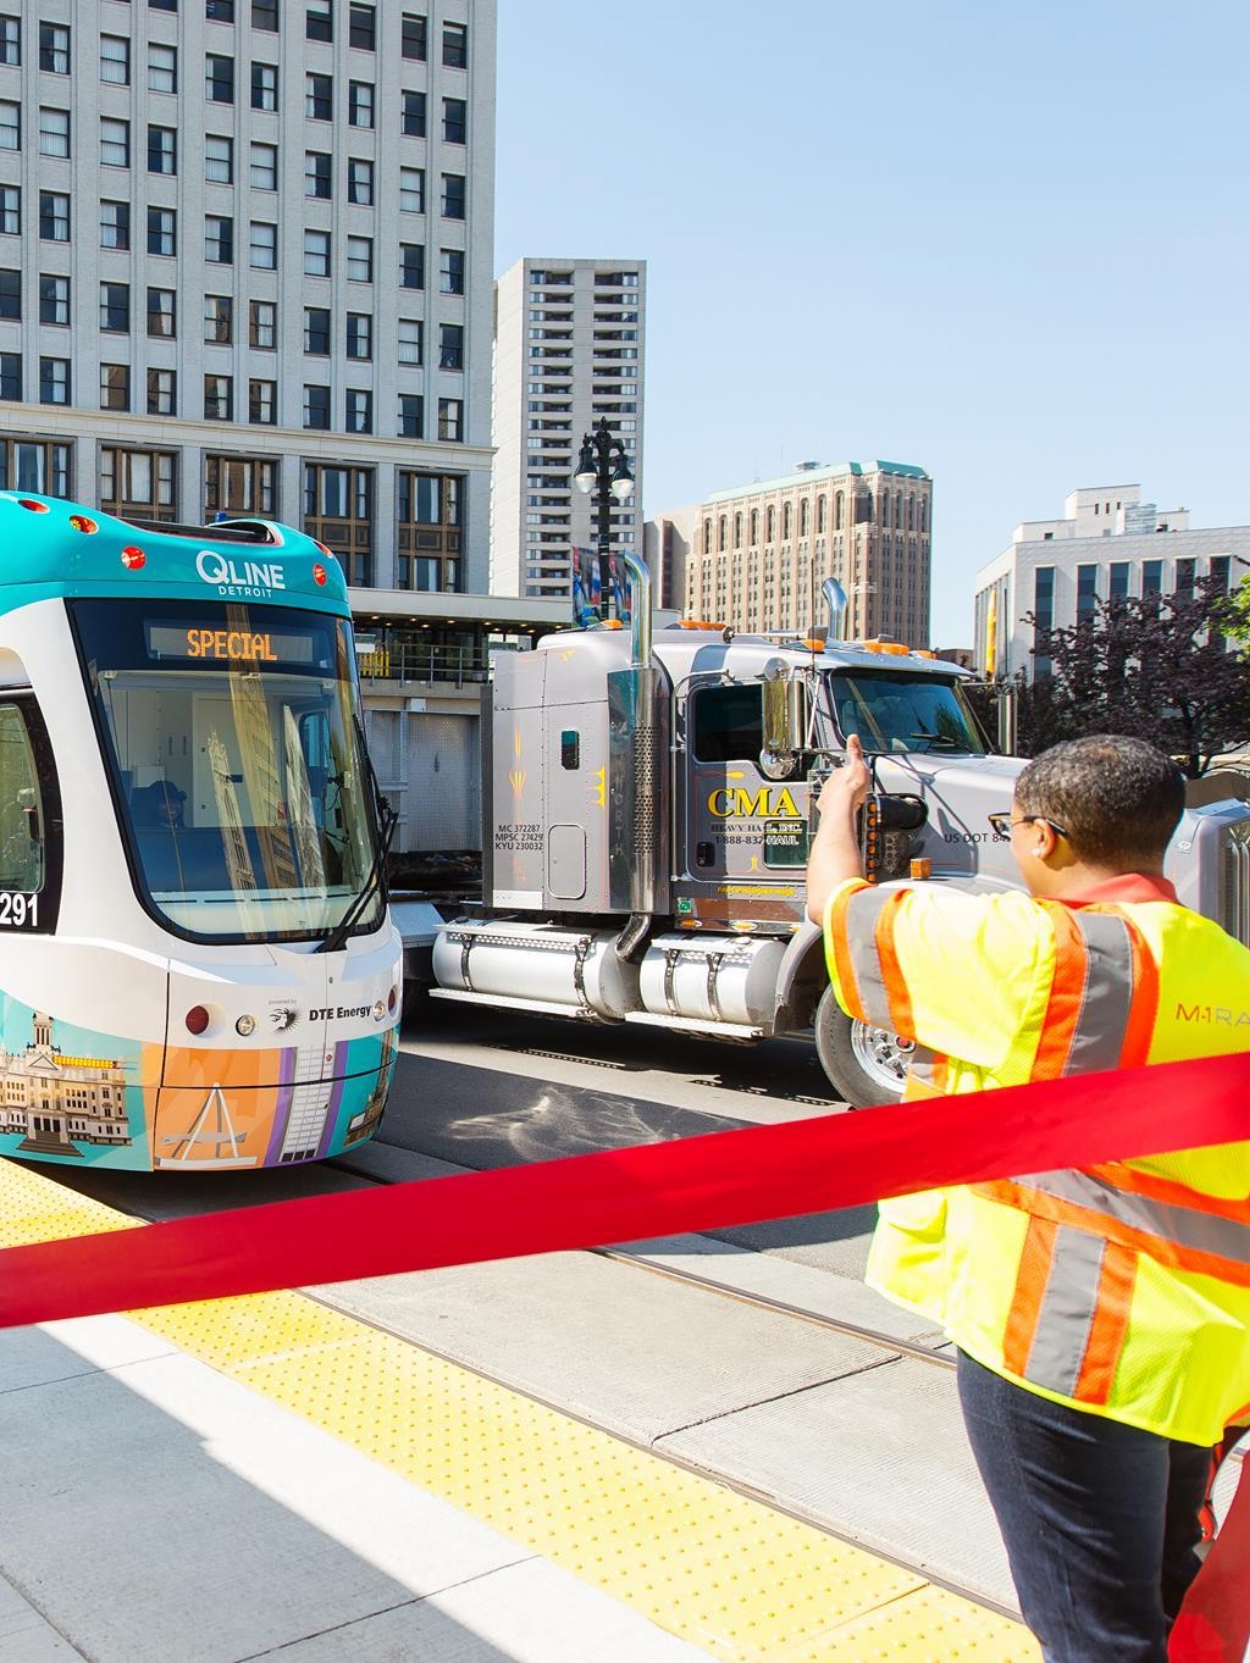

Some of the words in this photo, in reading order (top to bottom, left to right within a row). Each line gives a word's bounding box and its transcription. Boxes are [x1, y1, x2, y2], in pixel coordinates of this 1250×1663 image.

[196, 550, 286, 589] QLINE
[219, 586, 272, 598] DETROIT
[187, 629, 278, 661] SPECIAL
[706, 787, 802, 818] CMA
[498, 824, 513, 833] MC
[514, 824, 540, 833] 372287
[495, 833, 519, 841] MPSC
[944, 833, 960, 843] US
[963, 833, 989, 843] DOT
[495, 842, 514, 850] KYU
[515, 842, 543, 850] 230032
[309, 1008, 334, 1021] DTE
[337, 1005, 371, 1019] Energy
